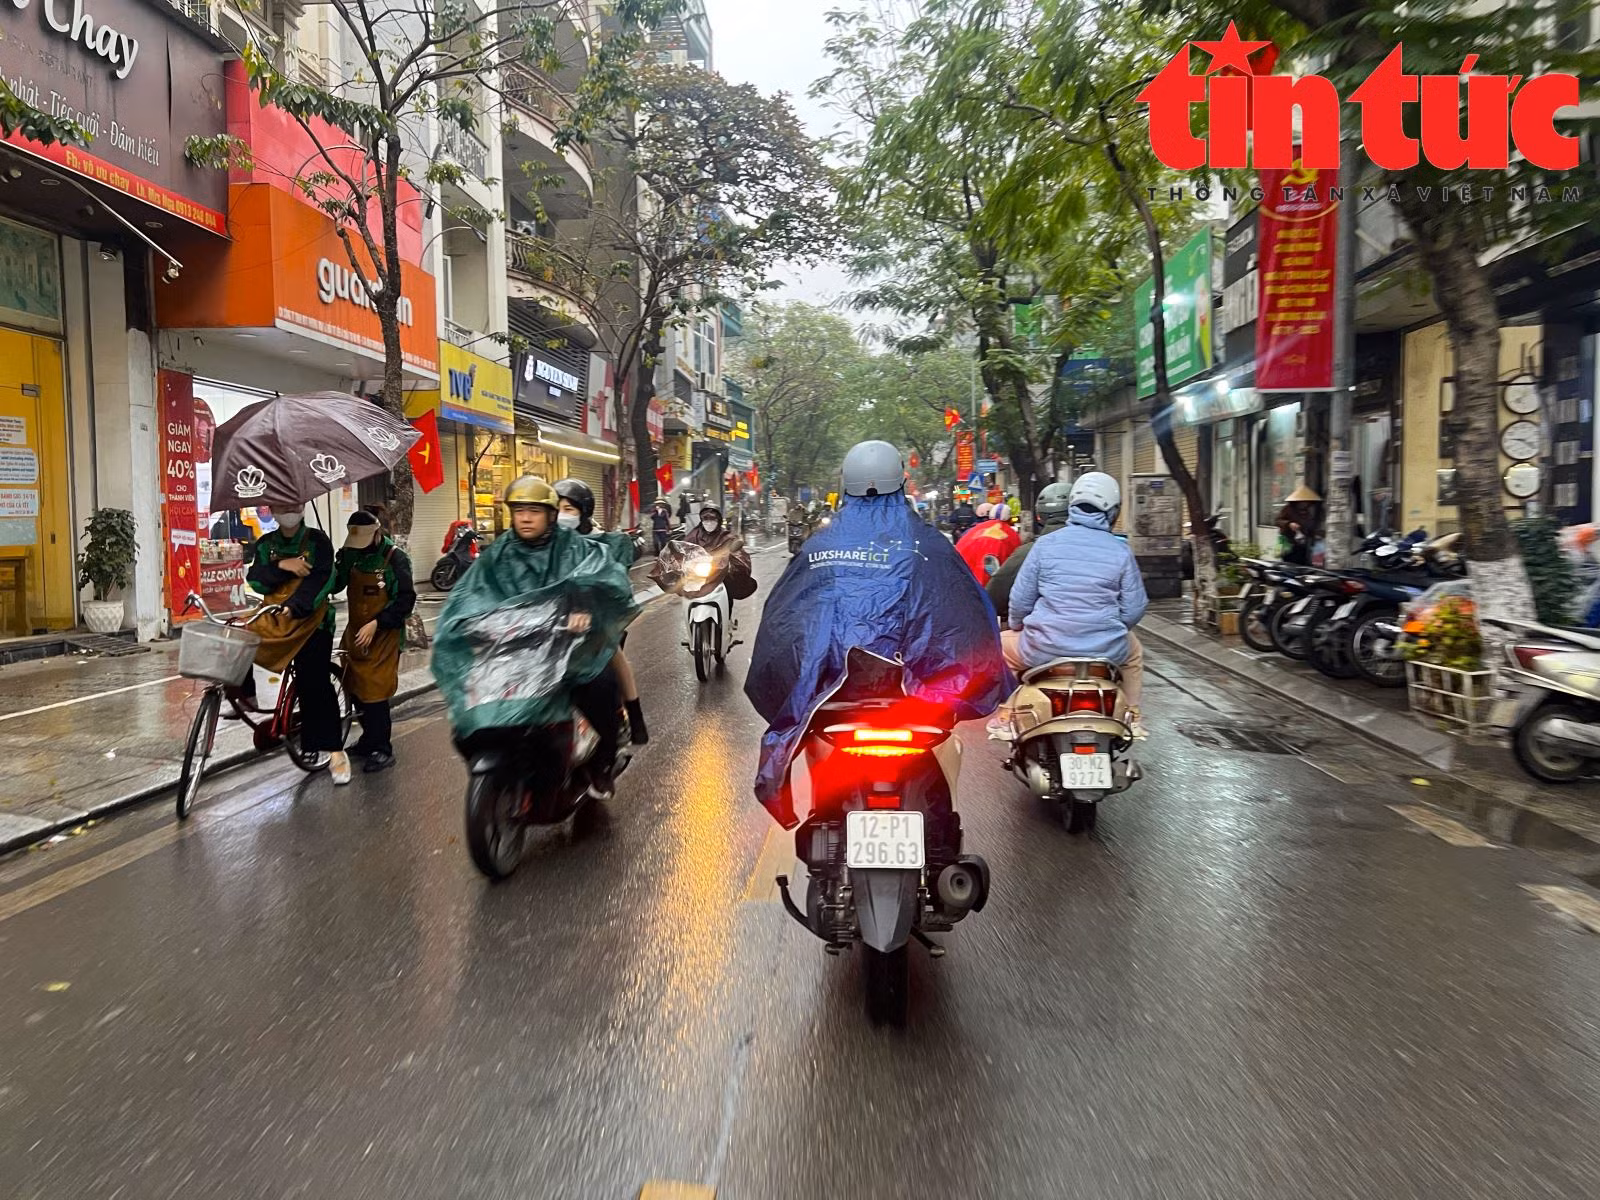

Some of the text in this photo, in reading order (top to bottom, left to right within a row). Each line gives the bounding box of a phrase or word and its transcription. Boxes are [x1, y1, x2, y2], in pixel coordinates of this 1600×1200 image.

[44, 0, 139, 79] Chay
[110, 120, 135, 155] Đám
[167, 420, 191, 437] GIẢM
[167, 440, 192, 454] NGAY
[166, 459, 195, 480] 40%
[176, 484, 188, 493] CHO
[860, 815, 910, 839] 12-P1
[852, 842, 919, 865] 296.63
